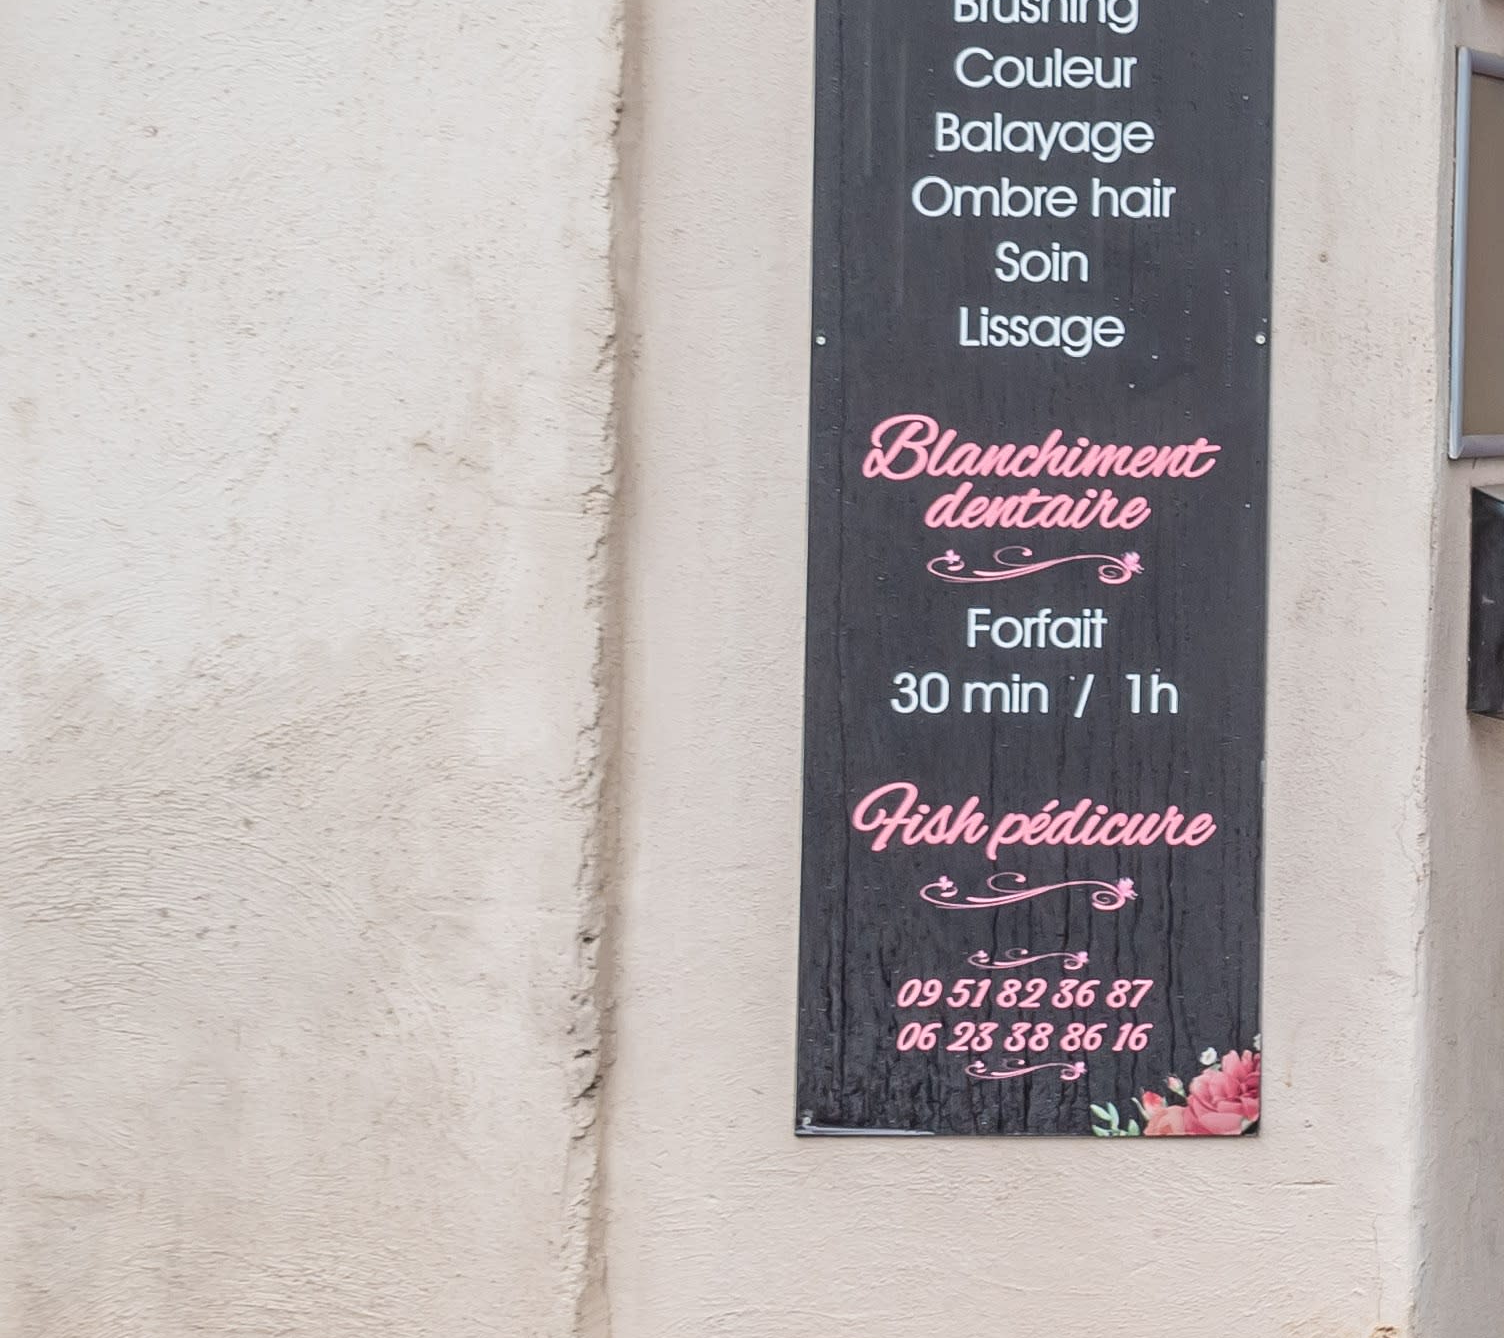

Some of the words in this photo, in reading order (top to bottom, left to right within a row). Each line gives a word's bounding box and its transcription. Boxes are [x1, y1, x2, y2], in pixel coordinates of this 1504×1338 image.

[955, 46, 1138, 89] Couleur
[935, 112, 1155, 163] Balayage
[911, 175, 1078, 218] Ombre
[1091, 177, 1177, 219] hair
[995, 241, 1089, 283] Soin
[959, 306, 1126, 358] Lissage
[862, 414, 1221, 480] Blanchiment
[925, 482, 1152, 530] dentaire
[967, 608, 1108, 649] Forfait
[890, 672, 950, 714] 30
[963, 673, 1049, 714] min
[1074, 673, 1095, 718] /
[1125, 673, 1178, 714] 1h
[852, 782, 989, 852] Fish
[987, 798, 1217, 861] pédicure
[897, 978, 943, 1008] 09
[946, 978, 990, 1008] 51
[996, 978, 1048, 1008] 82
[1051, 978, 1100, 1009] 36
[1105, 979, 1154, 1009] 87
[896, 1022, 940, 1051] 06
[946, 1021, 999, 1052] 23
[1003, 1021, 1054, 1052] 38
[1059, 1022, 1105, 1052] 86
[1111, 1022, 1154, 1052] 16
